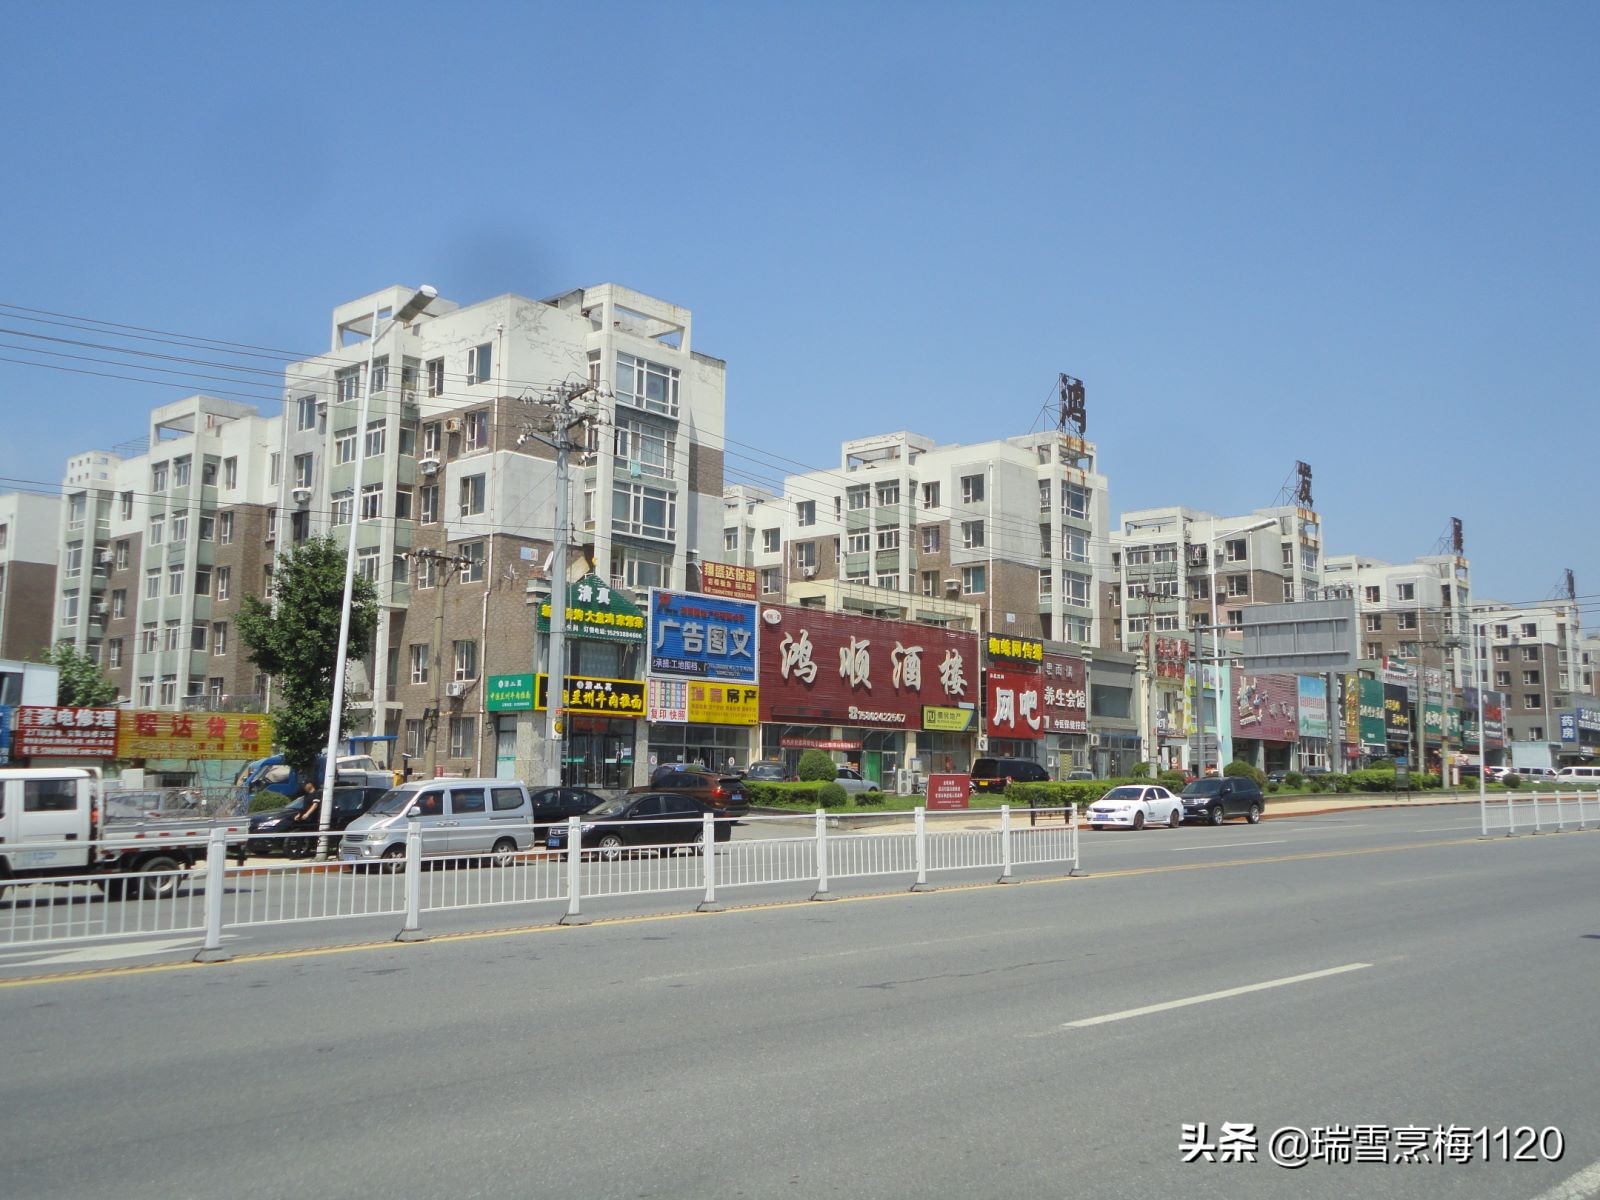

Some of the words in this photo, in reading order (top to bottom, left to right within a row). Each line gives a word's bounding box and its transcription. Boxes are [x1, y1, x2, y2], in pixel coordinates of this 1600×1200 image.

[577, 584, 611, 605] 清真
[656, 620, 752, 658] 广告图文
[988, 636, 1044, 661] 蜘蛛网传媒
[779, 628, 968, 697] 鸿顺酒楼
[546, 689, 642, 710] 兰州牛肉拉面
[992, 686, 1041, 731] 网吧
[1043, 685, 1086, 709] 养生会馆
[38, 707, 117, 728] 家电修理
[1560, 715, 1575, 739] 药房
